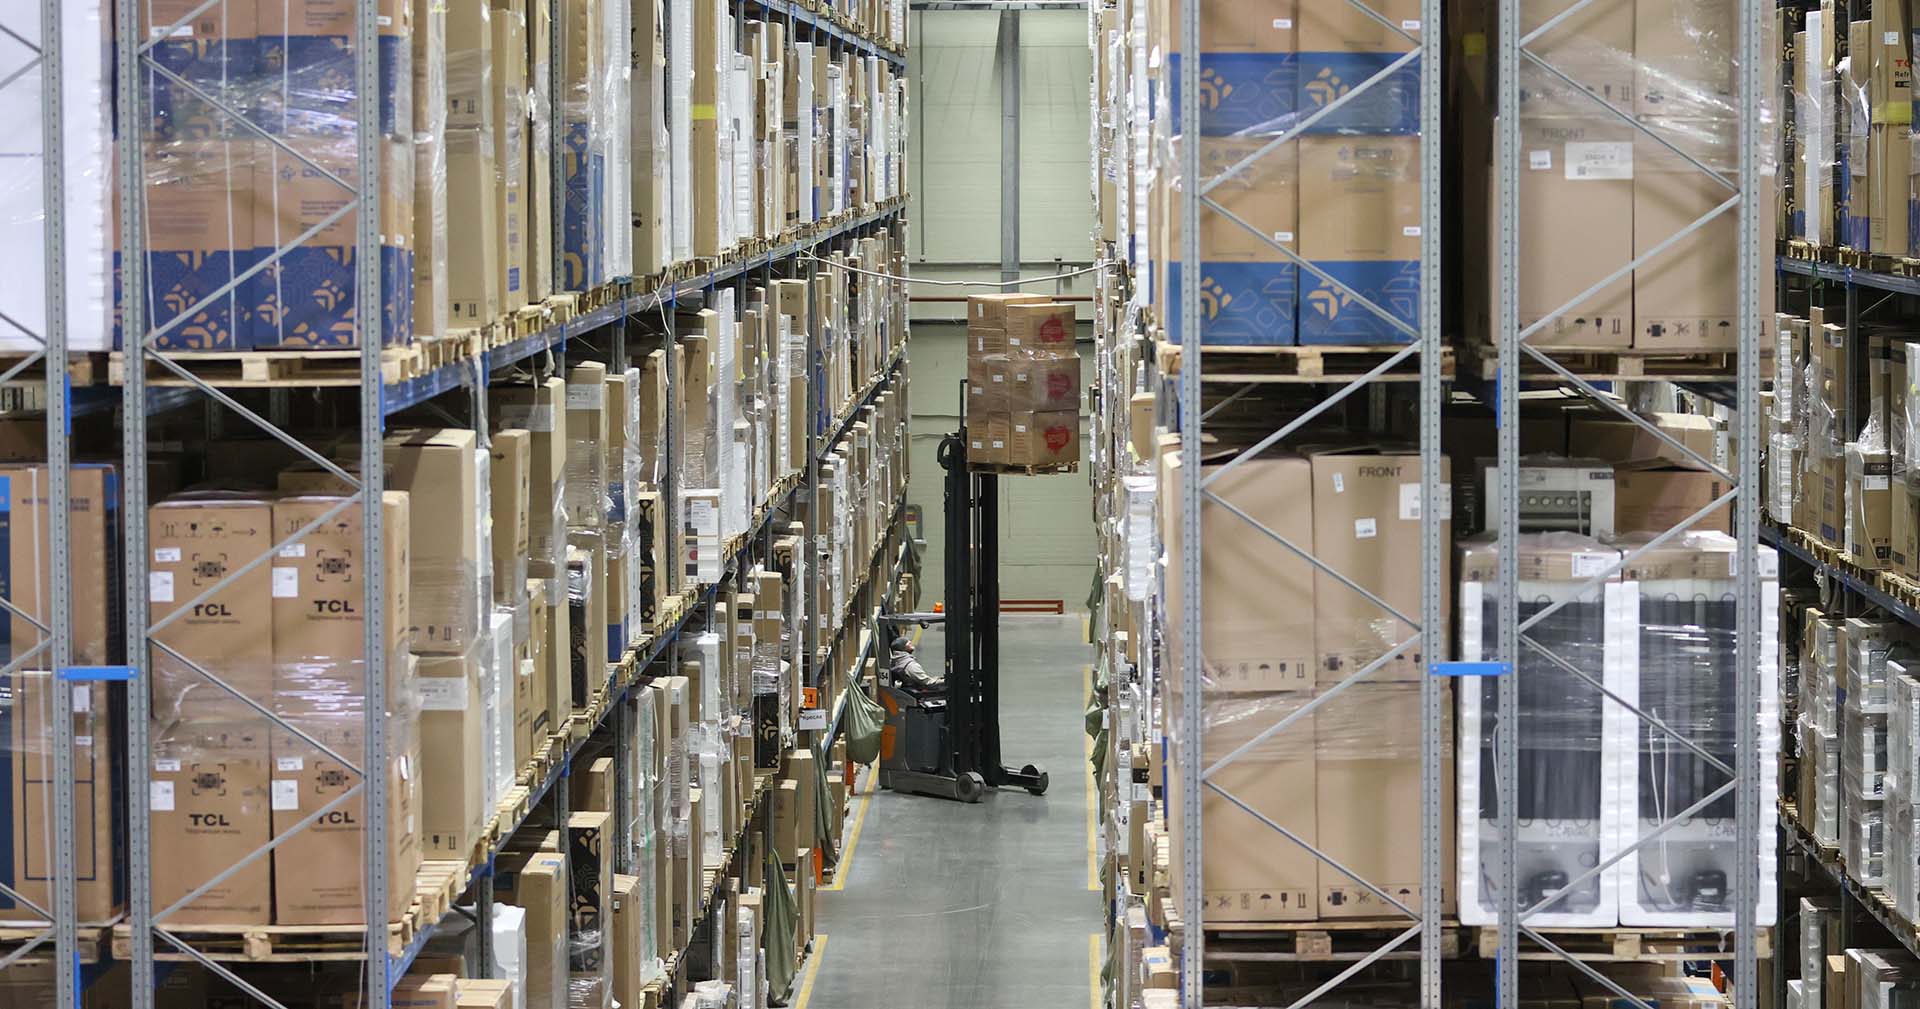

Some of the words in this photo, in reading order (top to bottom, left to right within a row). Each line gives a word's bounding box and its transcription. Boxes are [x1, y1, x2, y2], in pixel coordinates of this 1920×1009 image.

[1542, 127, 1585, 138] FRONT
[1359, 466, 1402, 477] FRONT
[193, 603, 232, 617] TCL
[313, 600, 354, 613] TCL
[189, 813, 230, 827] TCL
[317, 811, 355, 825] TCL
